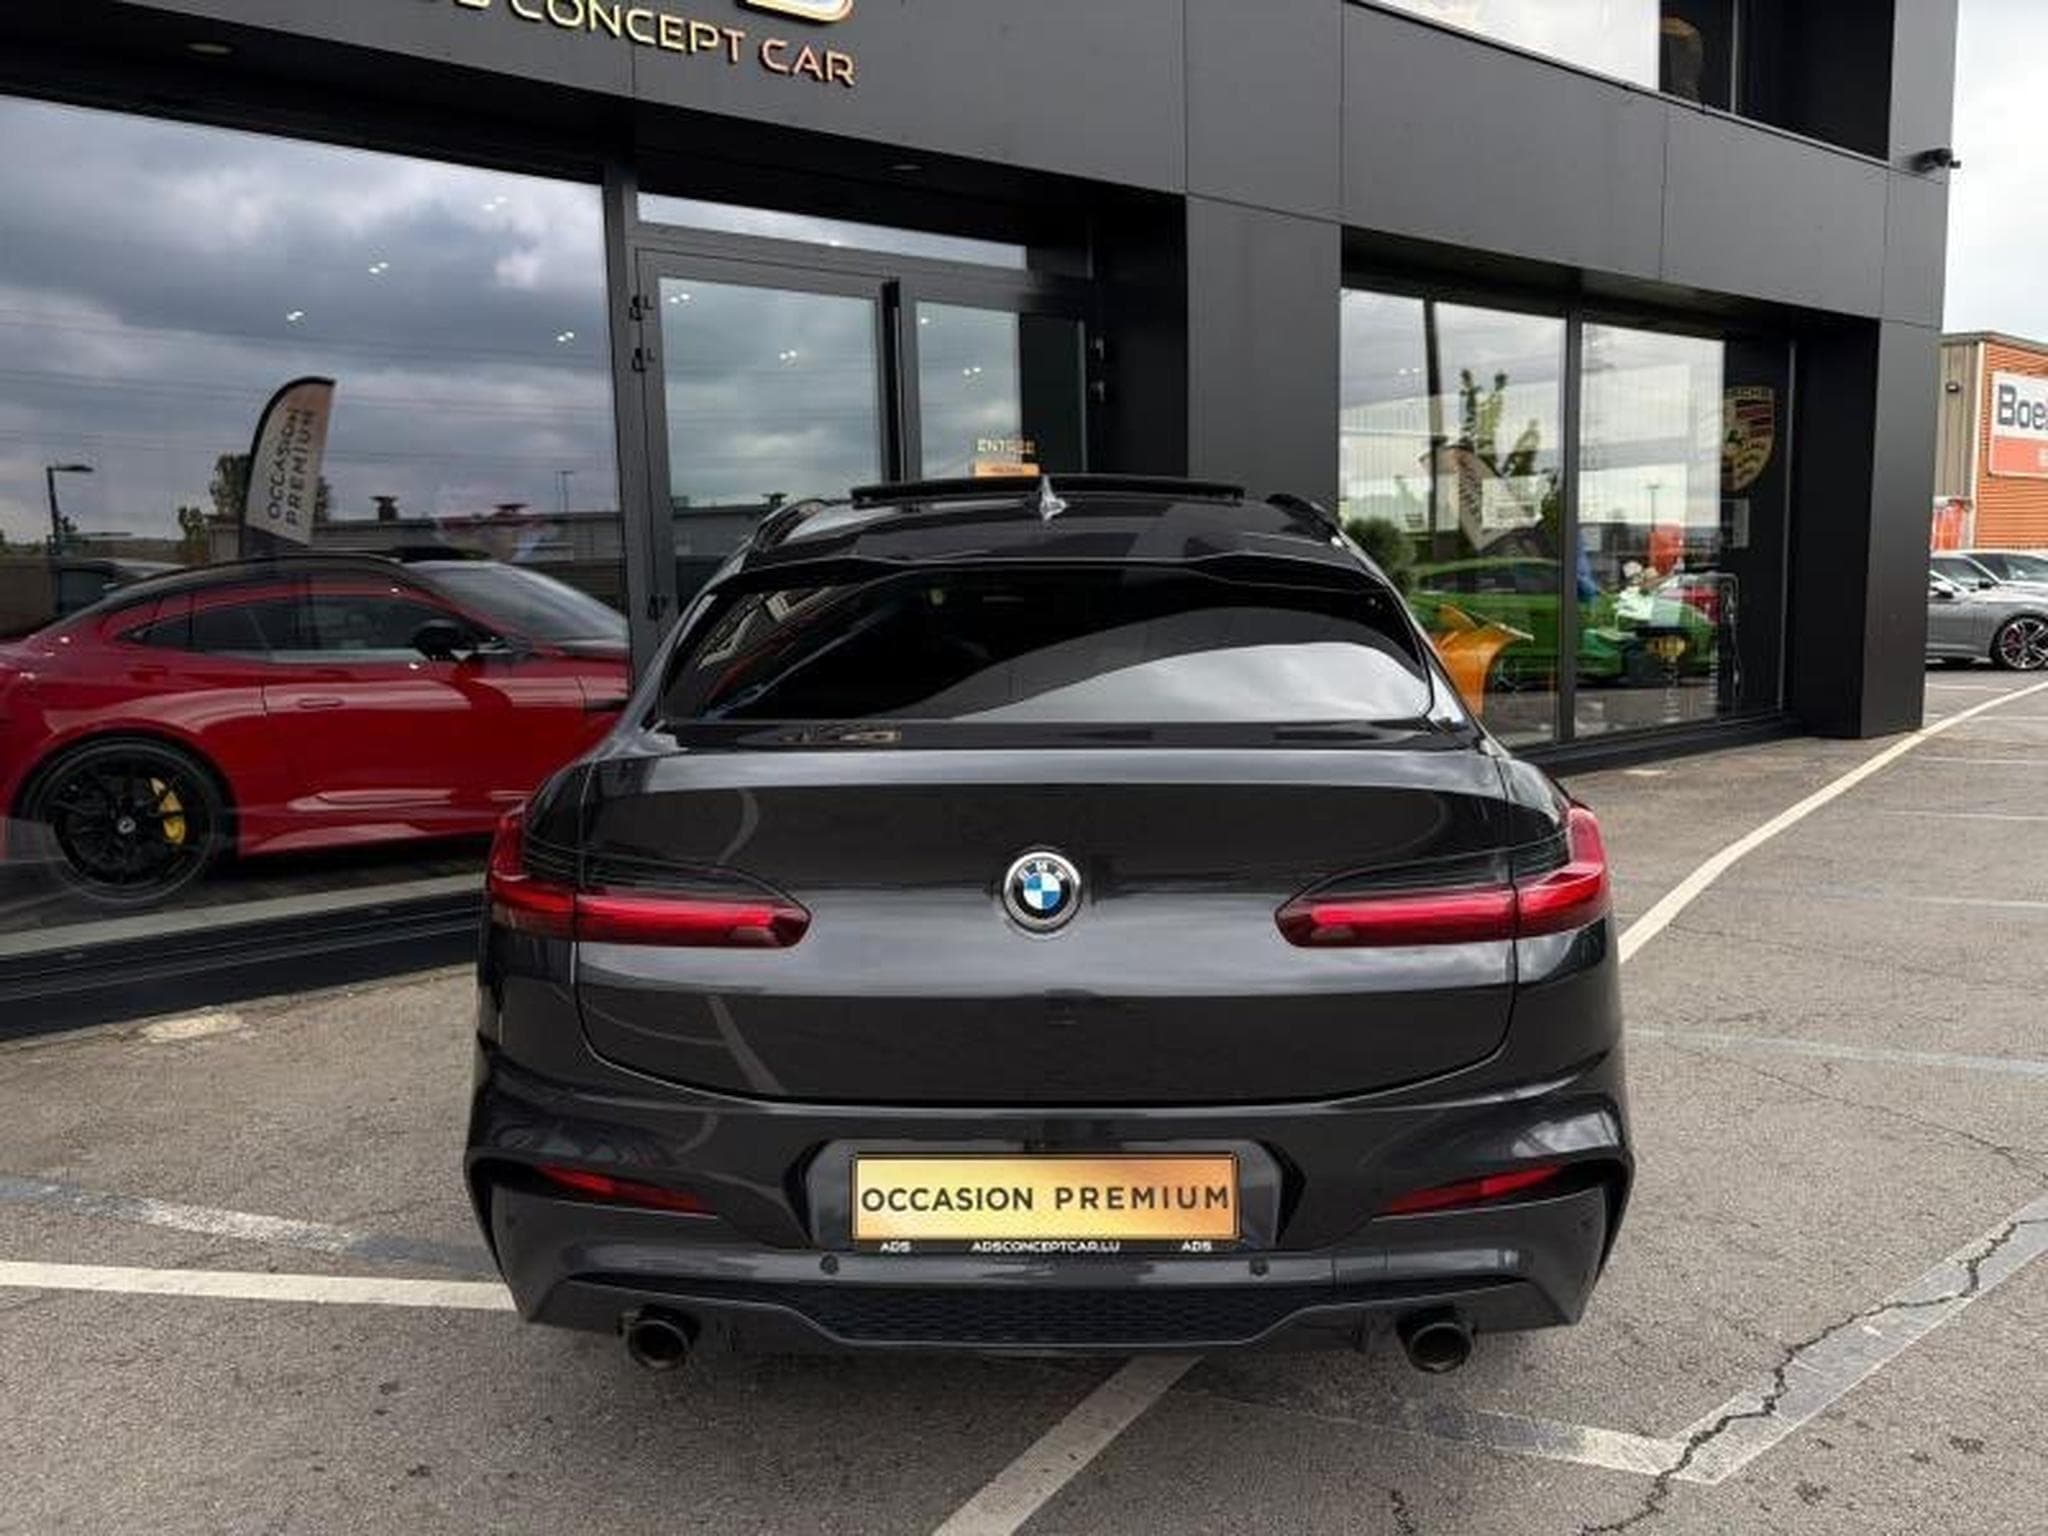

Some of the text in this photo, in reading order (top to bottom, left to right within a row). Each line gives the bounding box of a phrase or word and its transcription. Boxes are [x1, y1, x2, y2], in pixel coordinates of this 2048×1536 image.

[509, 0, 745, 62] CONCEPT
[761, 38, 854, 85] CAR
[1998, 384, 2048, 430] Boe
[267, 408, 300, 519] OCCASION
[286, 409, 315, 525] PREMIUM
[861, 1186, 1229, 1211] OCCASION PREMIUM
[880, 1242, 911, 1253] ADS
[1181, 1242, 1212, 1253] ADS
